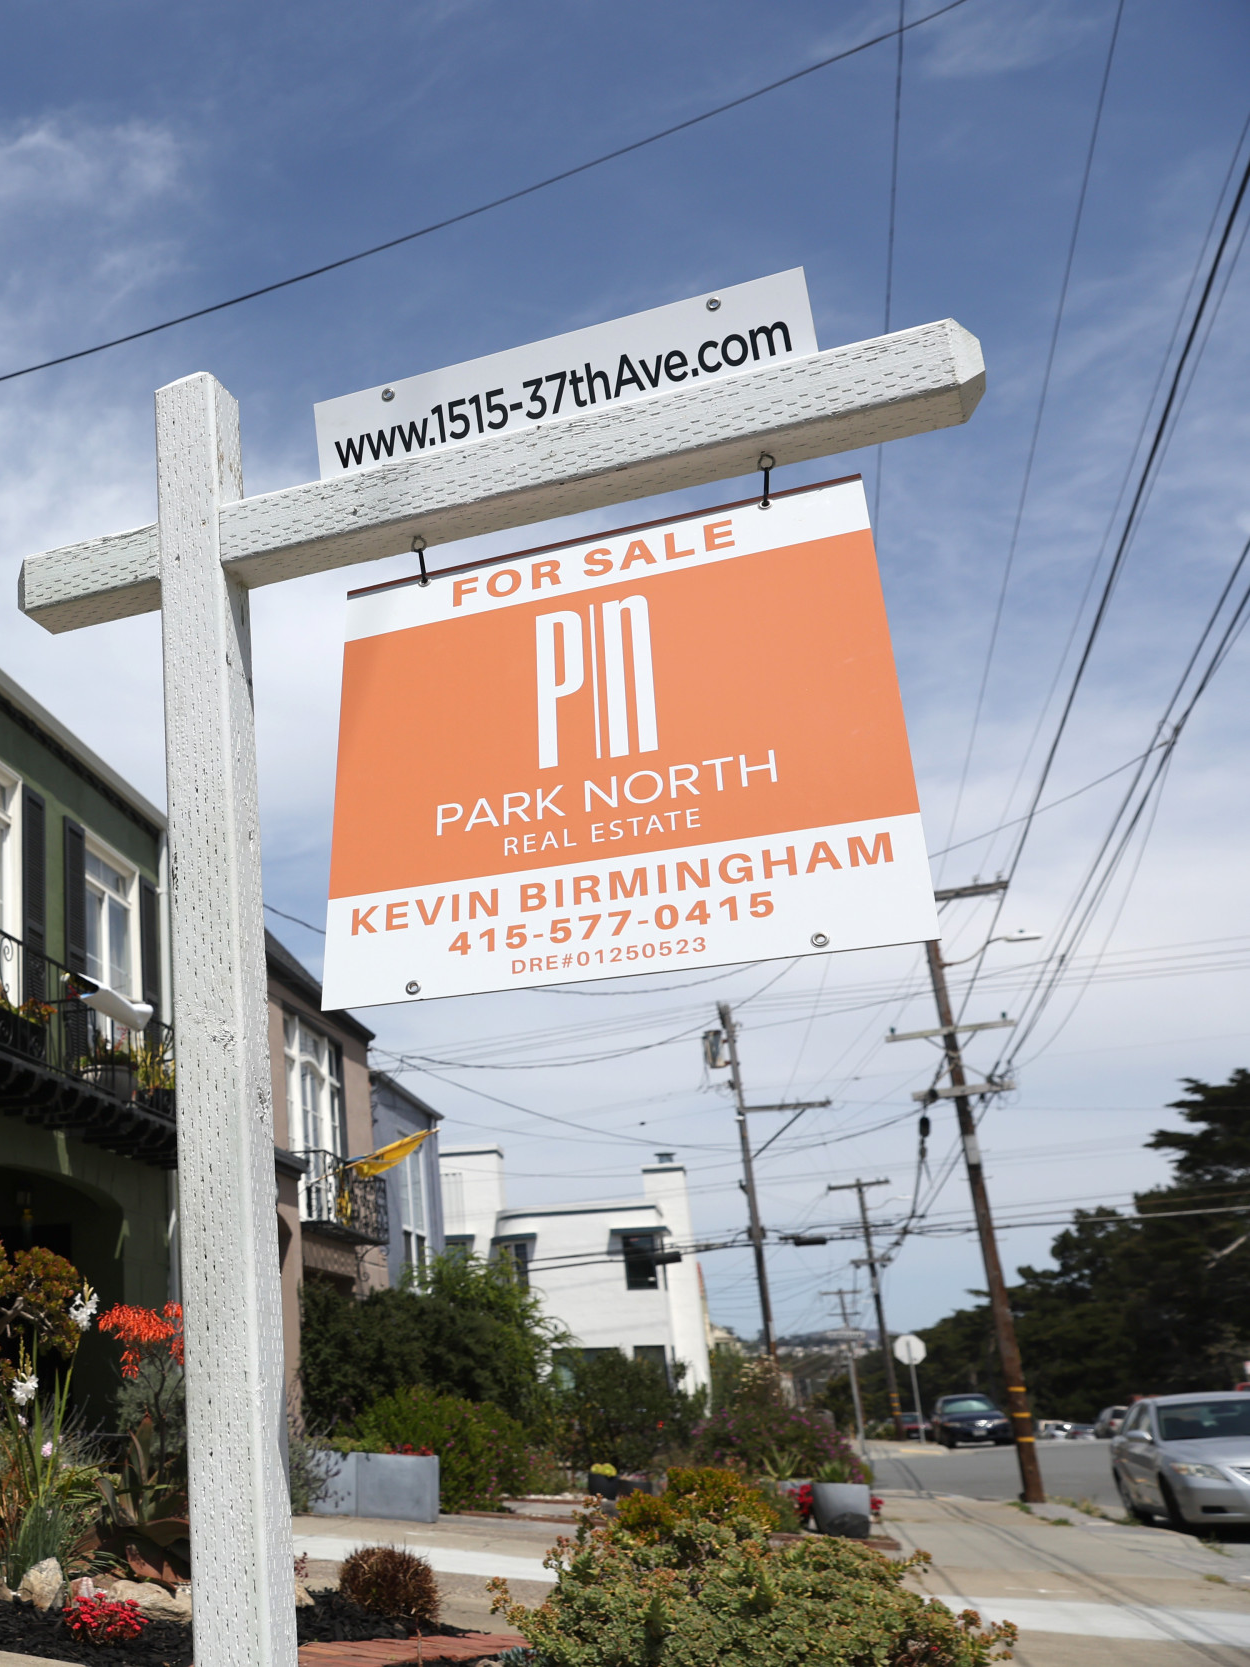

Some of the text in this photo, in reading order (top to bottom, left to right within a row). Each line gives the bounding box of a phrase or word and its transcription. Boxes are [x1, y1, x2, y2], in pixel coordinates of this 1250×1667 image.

[334, 321, 793, 469] www.1515-37thAve.com
[453, 519, 736, 607] FOR SALE
[435, 749, 778, 836] PARK NORTH
[504, 808, 702, 857] REAL ESTATE
[350, 831, 895, 936] KEVIN BIRMINGHAM
[447, 890, 776, 956] 415-577-0415
[511, 936, 707, 975] DRE#01250523
